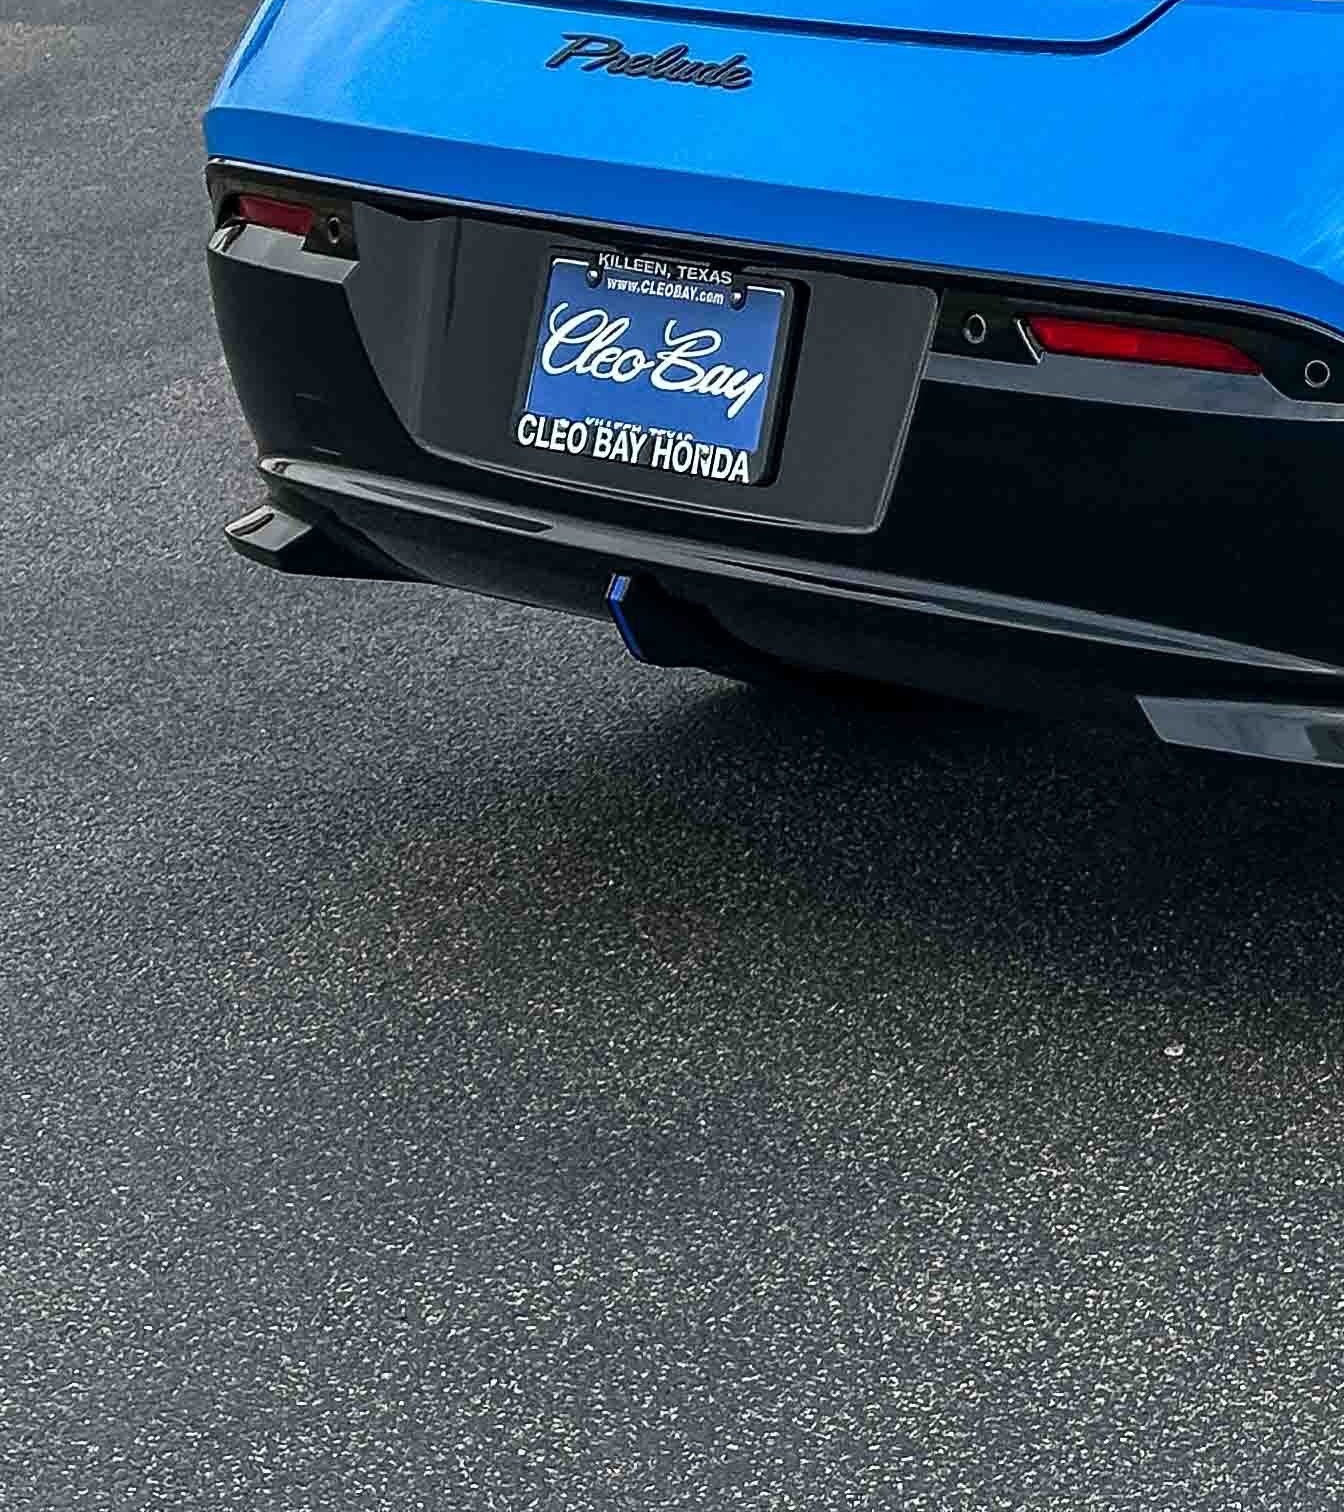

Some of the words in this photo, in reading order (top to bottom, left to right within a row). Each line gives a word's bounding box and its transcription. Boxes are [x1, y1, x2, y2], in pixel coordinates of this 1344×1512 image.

[545, 32, 752, 90] Prelude
[599, 253, 671, 279] KILLEEN,
[677, 265, 732, 284] TEXAS
[607, 278, 724, 305] www.CLEOBAY.com
[541, 302, 655, 383] Cleo
[649, 319, 764, 419] Bay
[517, 413, 587, 454] CLEO
[592, 426, 648, 465] BAY
[650, 436, 751, 484] HONDA
